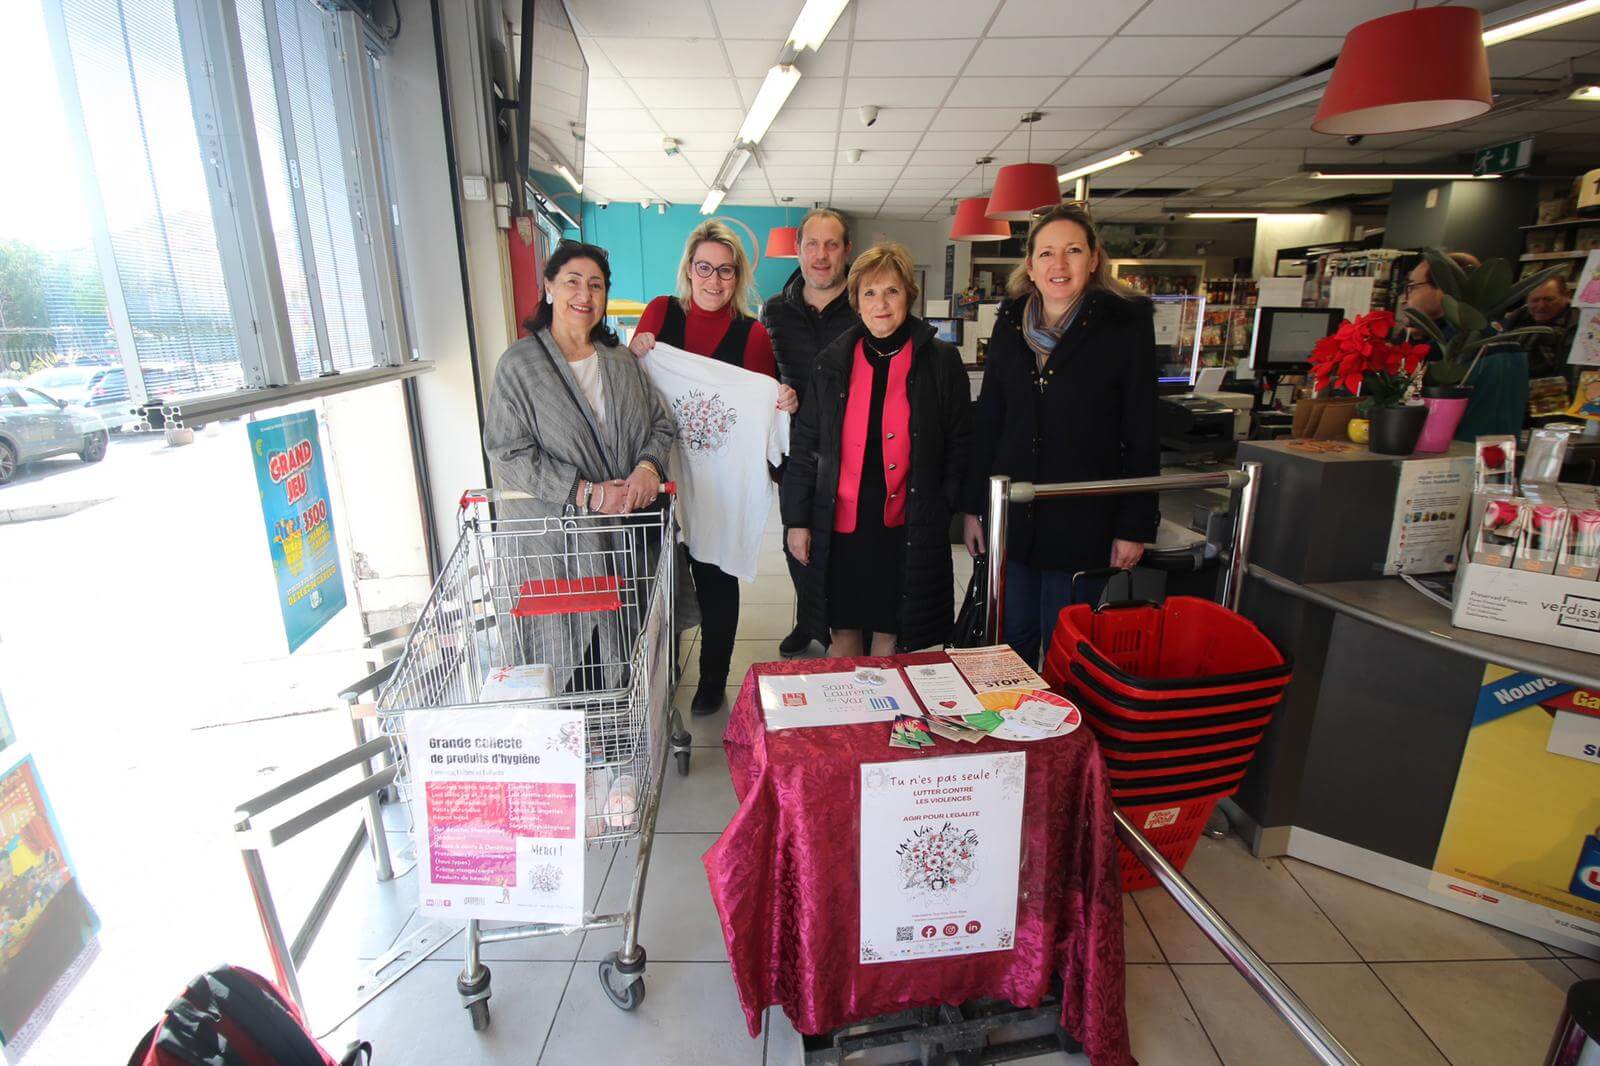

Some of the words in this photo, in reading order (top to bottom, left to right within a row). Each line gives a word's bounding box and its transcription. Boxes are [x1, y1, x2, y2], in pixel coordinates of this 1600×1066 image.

[269, 439, 312, 483] GRAND
[286, 470, 307, 505] JEU
[302, 498, 327, 534] 3500
[822, 683, 855, 691] Saint
[984, 678, 1020, 688] STOP
[823, 688, 876, 698] Laurent
[840, 697, 864, 705] Var
[429, 737, 471, 749] Grande
[430, 753, 444, 764] de
[446, 753, 489, 765] produits
[492, 753, 541, 766] d'hygiène
[890, 776, 905, 786] Tu
[910, 775, 932, 785] n'es
[936, 774, 957, 788] pas
[962, 769, 990, 781] seule
[913, 787, 941, 796] LUTTER
[942, 786, 974, 795] CONTRE
[930, 795, 972, 804] VIOLENCES
